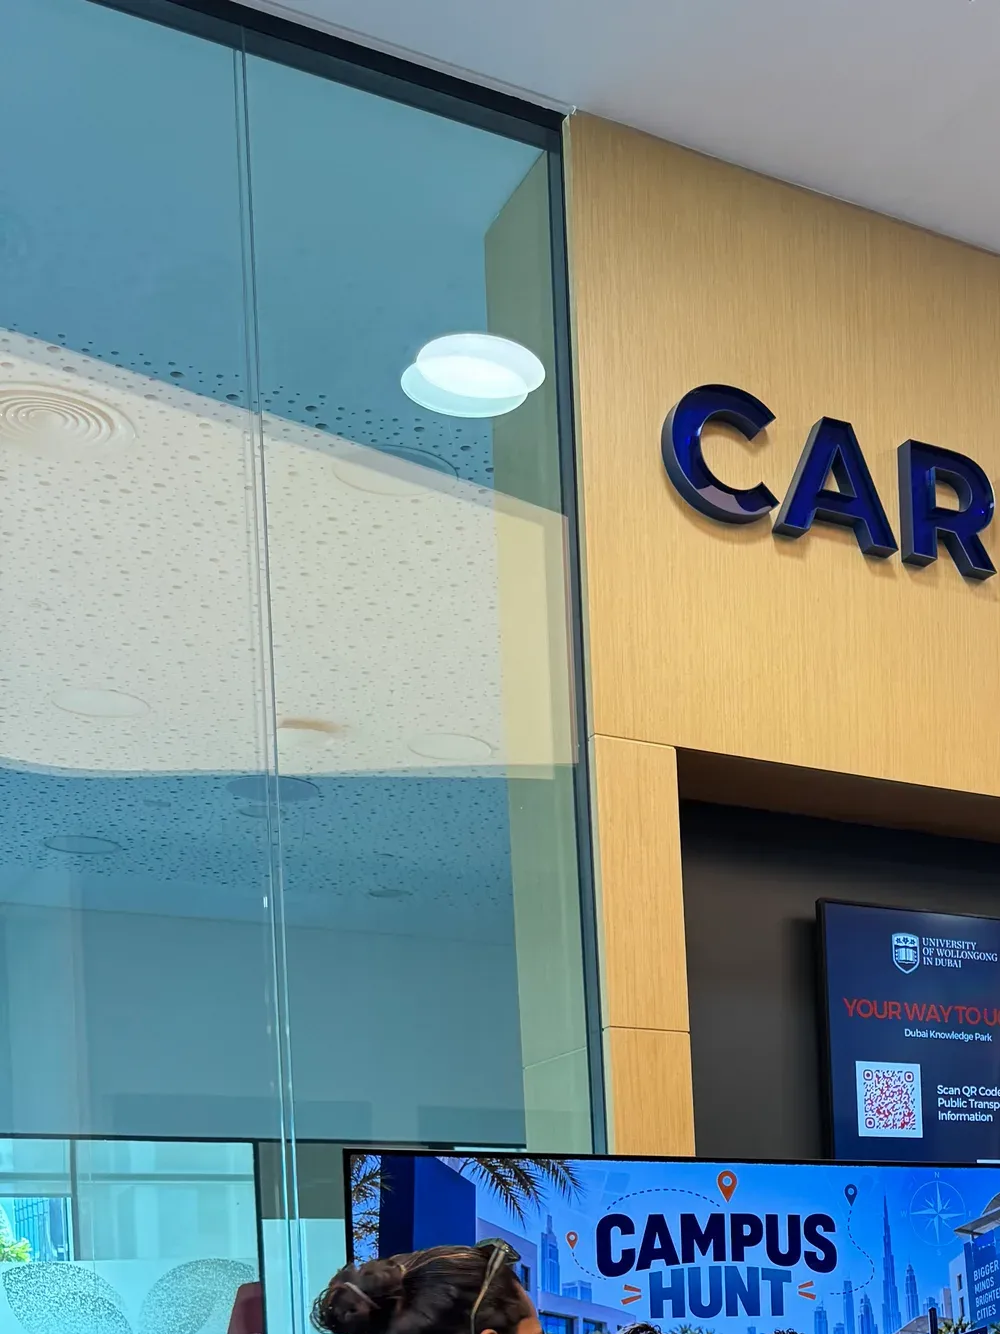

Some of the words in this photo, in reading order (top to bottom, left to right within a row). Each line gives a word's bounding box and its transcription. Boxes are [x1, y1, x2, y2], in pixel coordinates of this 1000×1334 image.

[922, 937, 977, 951] UNIVERSITY
[922, 947, 935, 956] OF
[936, 948, 998, 962] WOLLONGONG
[923, 957, 934, 966] IN
[934, 958, 962, 969] DUBAI
[843, 997, 902, 1020] YOUR
[904, 1002, 953, 1024] WAY
[954, 1005, 981, 1025] TO
[904, 1028, 929, 1039] Dubai
[929, 1030, 974, 1043] Knowledge
[974, 1033, 993, 1043] Park
[937, 1085, 961, 1096] Scan
[962, 1086, 977, 1097] QR
[938, 1098, 968, 1109] Public
[938, 1111, 994, 1123] Information
[595, 1212, 838, 1277] CAMPUS
[973, 1259, 1000, 1281] BIGGER
[649, 1265, 792, 1318] HUNT
[974, 1276, 995, 1295] MINDS
[976, 1304, 997, 1321] CITIES
